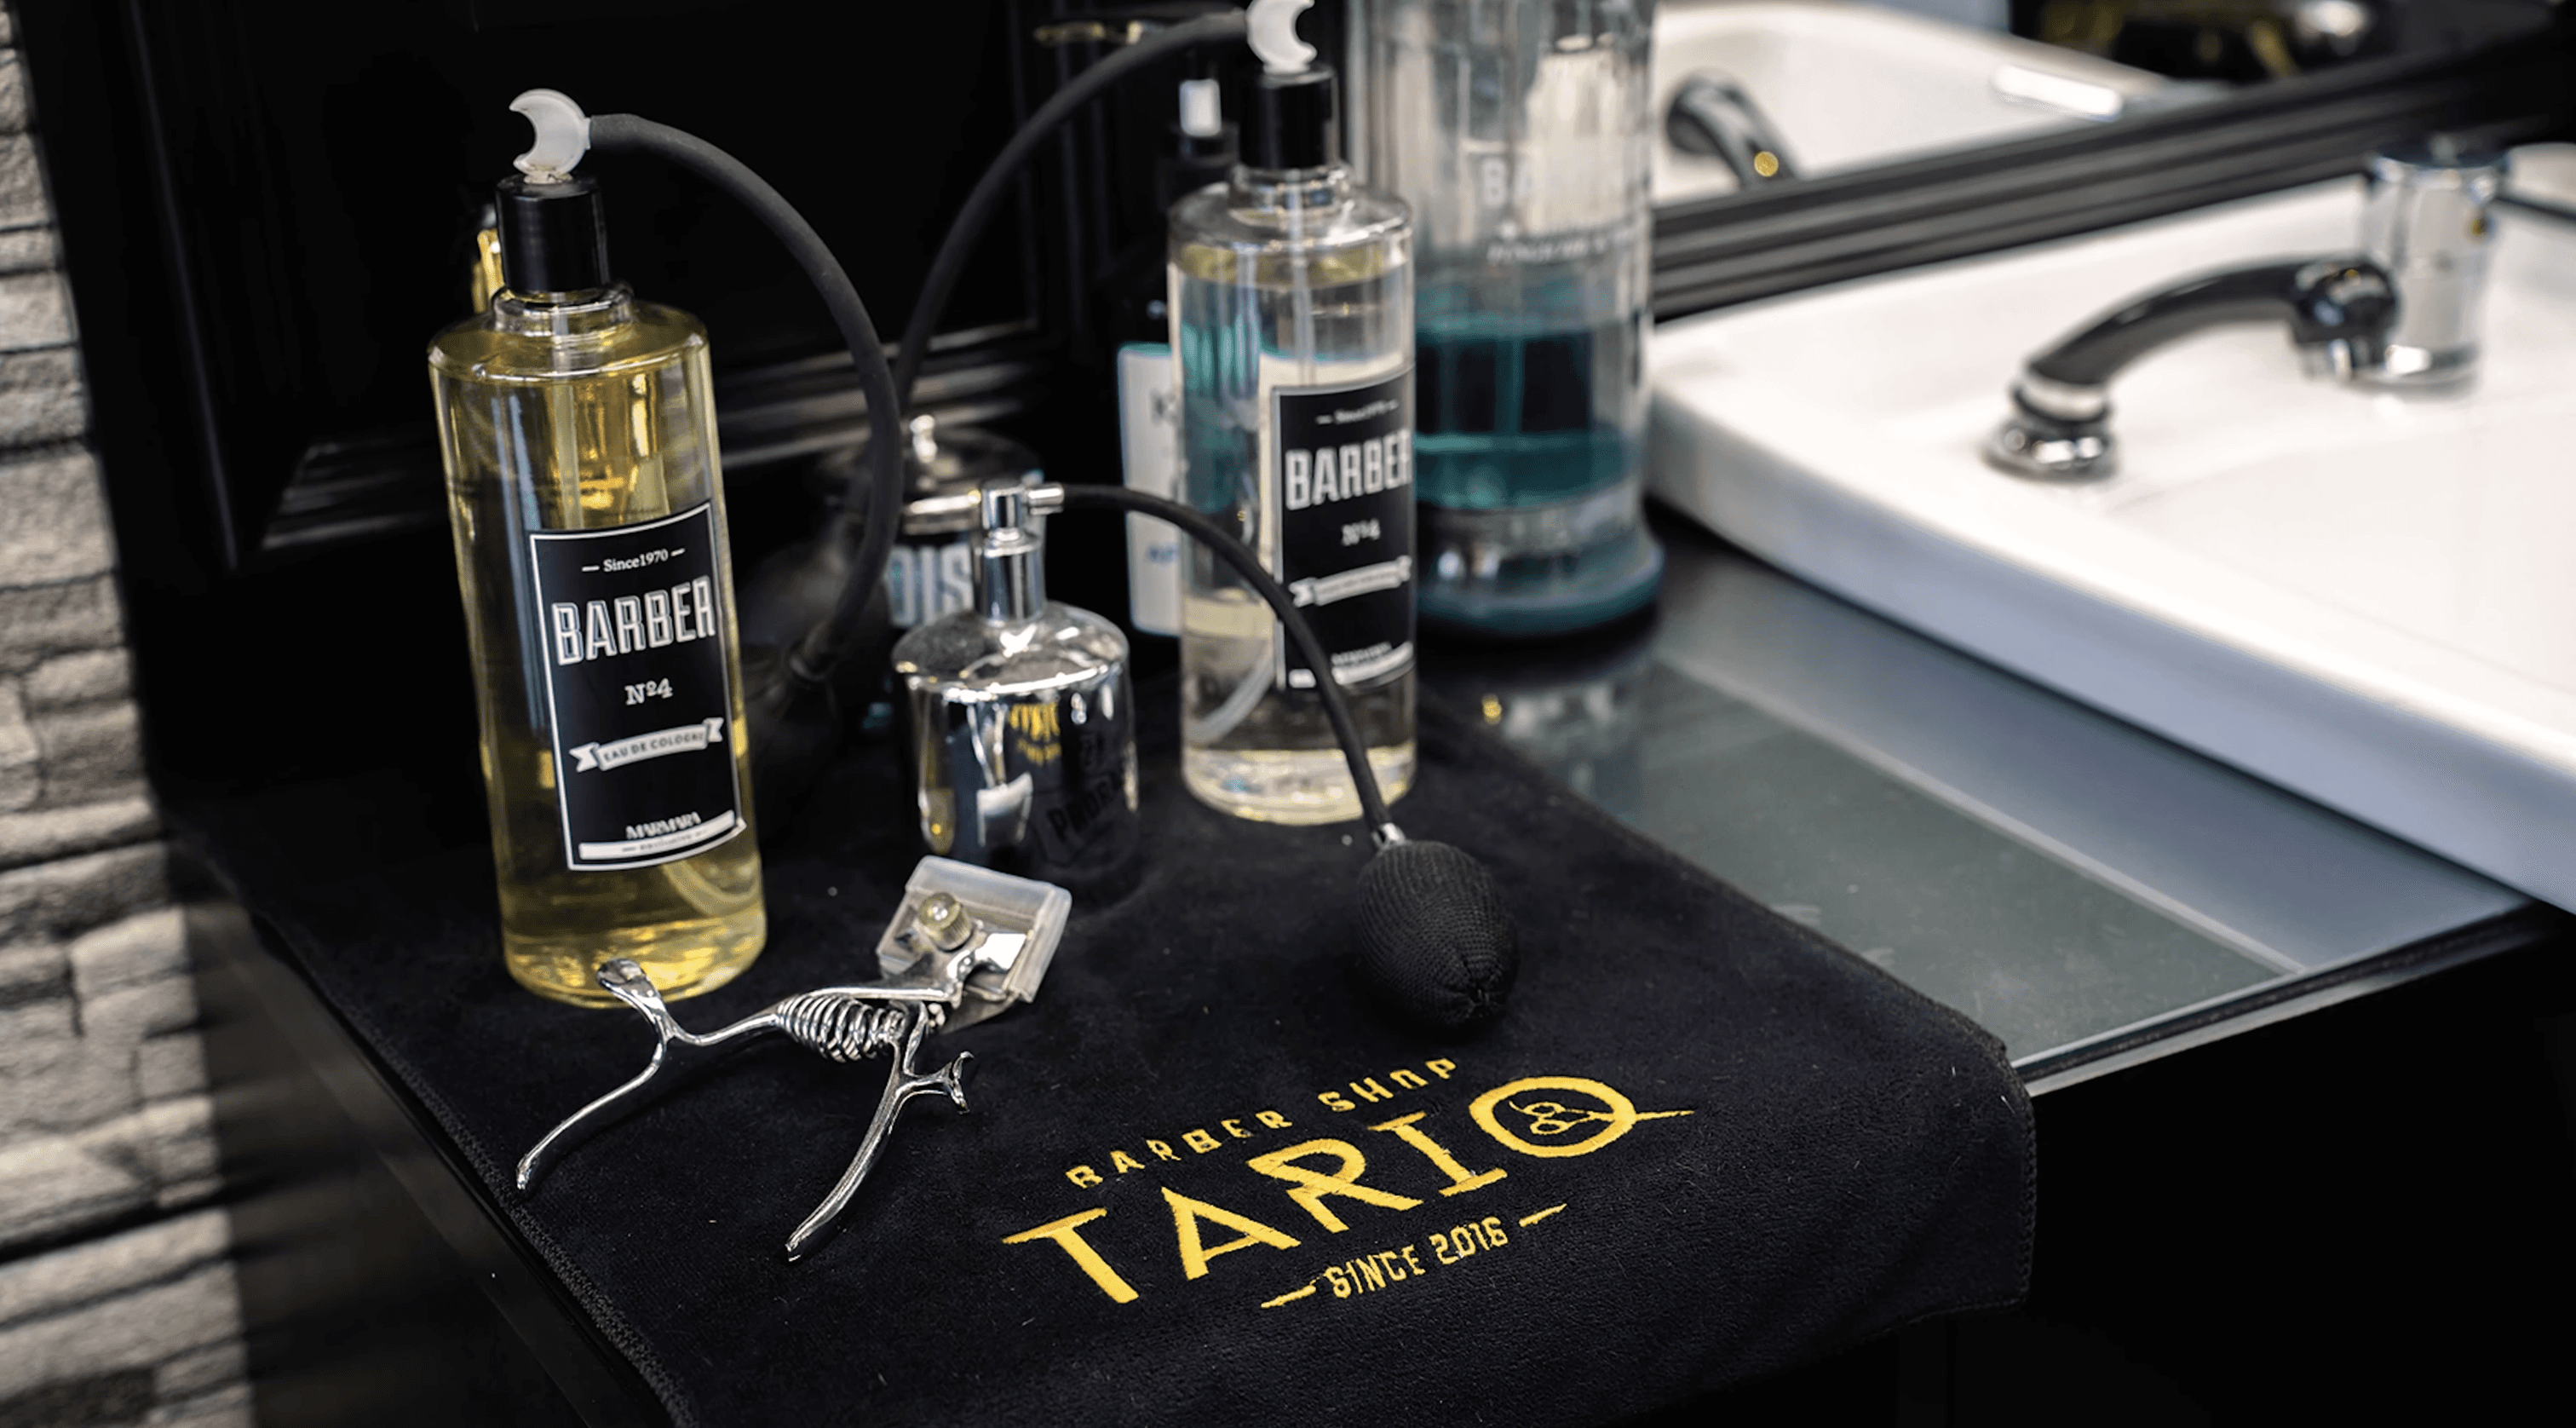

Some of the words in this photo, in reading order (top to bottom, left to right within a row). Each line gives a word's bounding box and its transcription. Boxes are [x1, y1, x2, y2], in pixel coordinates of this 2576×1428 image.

[1285, 428, 1412, 510] BARBER
[602, 548, 669, 573] Since1970
[551, 575, 716, 666] BARBER
[603, 747, 628, 763] EAU
[631, 743, 647, 755] DE
[1065, 1110, 1293, 1189] BARBER
[1317, 1057, 1456, 1112] SHOP
[1323, 1244, 1425, 1299] SINCE
[1429, 1216, 1509, 1265] 2016
